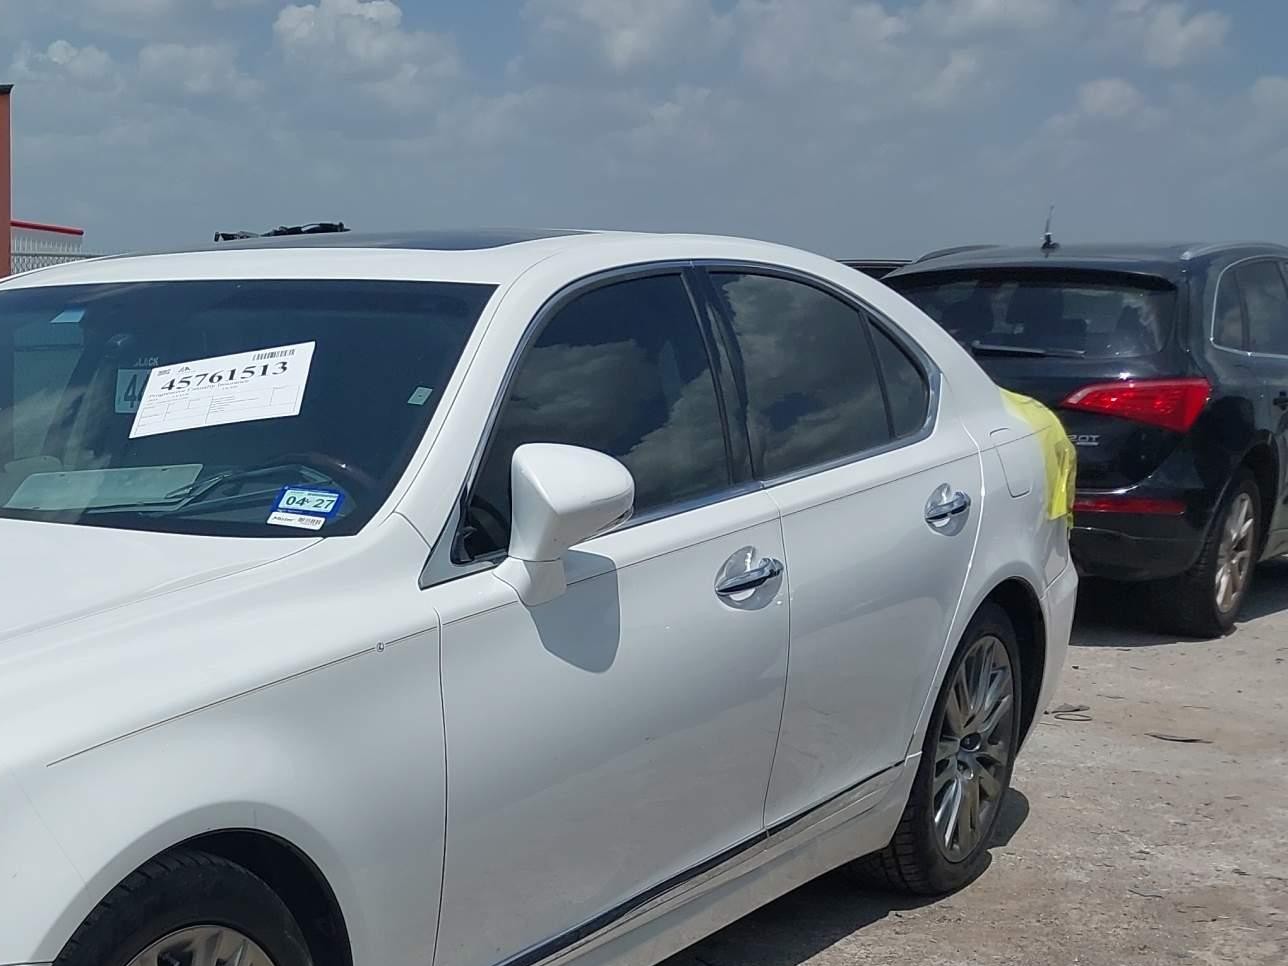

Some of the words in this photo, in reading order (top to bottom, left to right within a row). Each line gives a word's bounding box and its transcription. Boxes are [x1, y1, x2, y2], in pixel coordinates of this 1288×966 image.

[160, 361, 289, 391] 45761513
[285, 495, 306, 506] 04
[312, 498, 334, 509] 27
